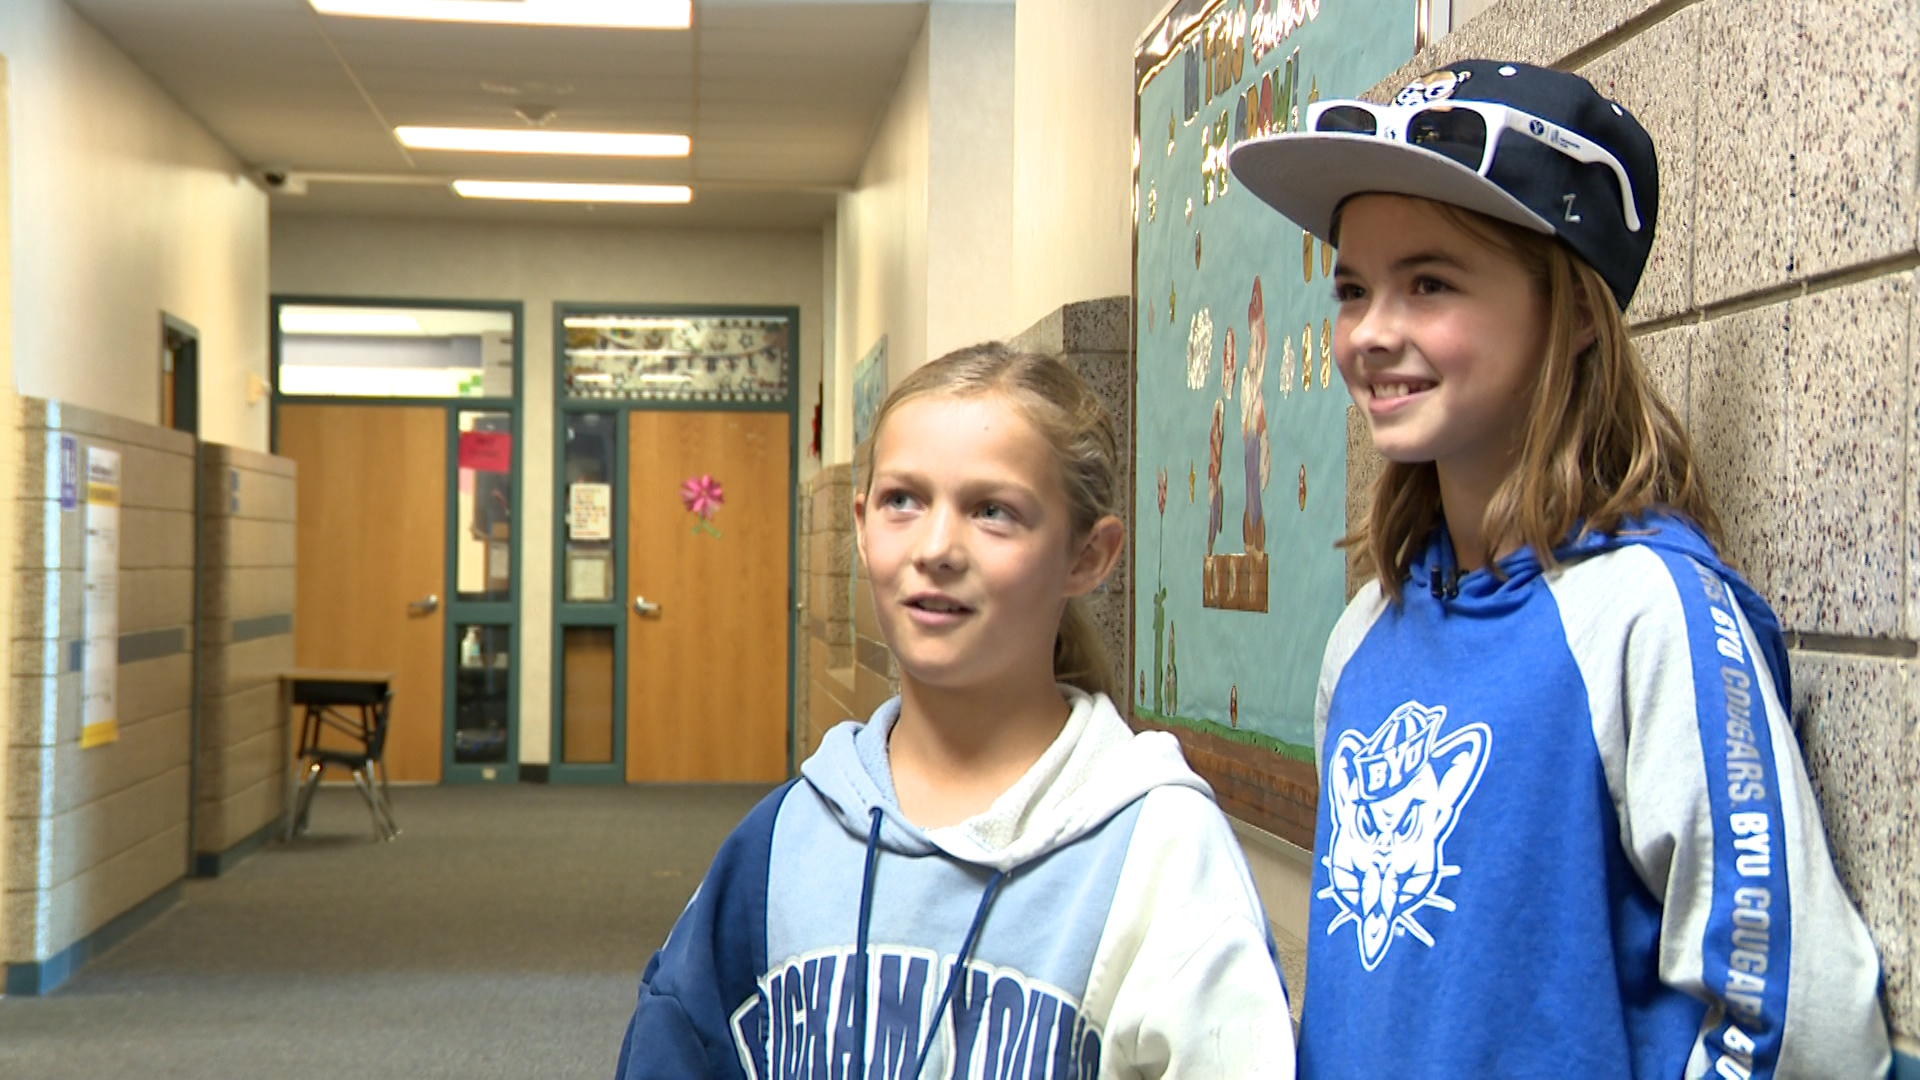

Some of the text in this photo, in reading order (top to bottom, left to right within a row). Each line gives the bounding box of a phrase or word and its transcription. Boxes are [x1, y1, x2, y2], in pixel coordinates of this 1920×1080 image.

[1562, 193, 1582, 223] Z
[1368, 738, 1425, 792] BYU
[1720, 665, 1766, 803] COUGARS
[1730, 812, 1771, 878] BYU
[1724, 886, 1771, 1032] COUGAR
